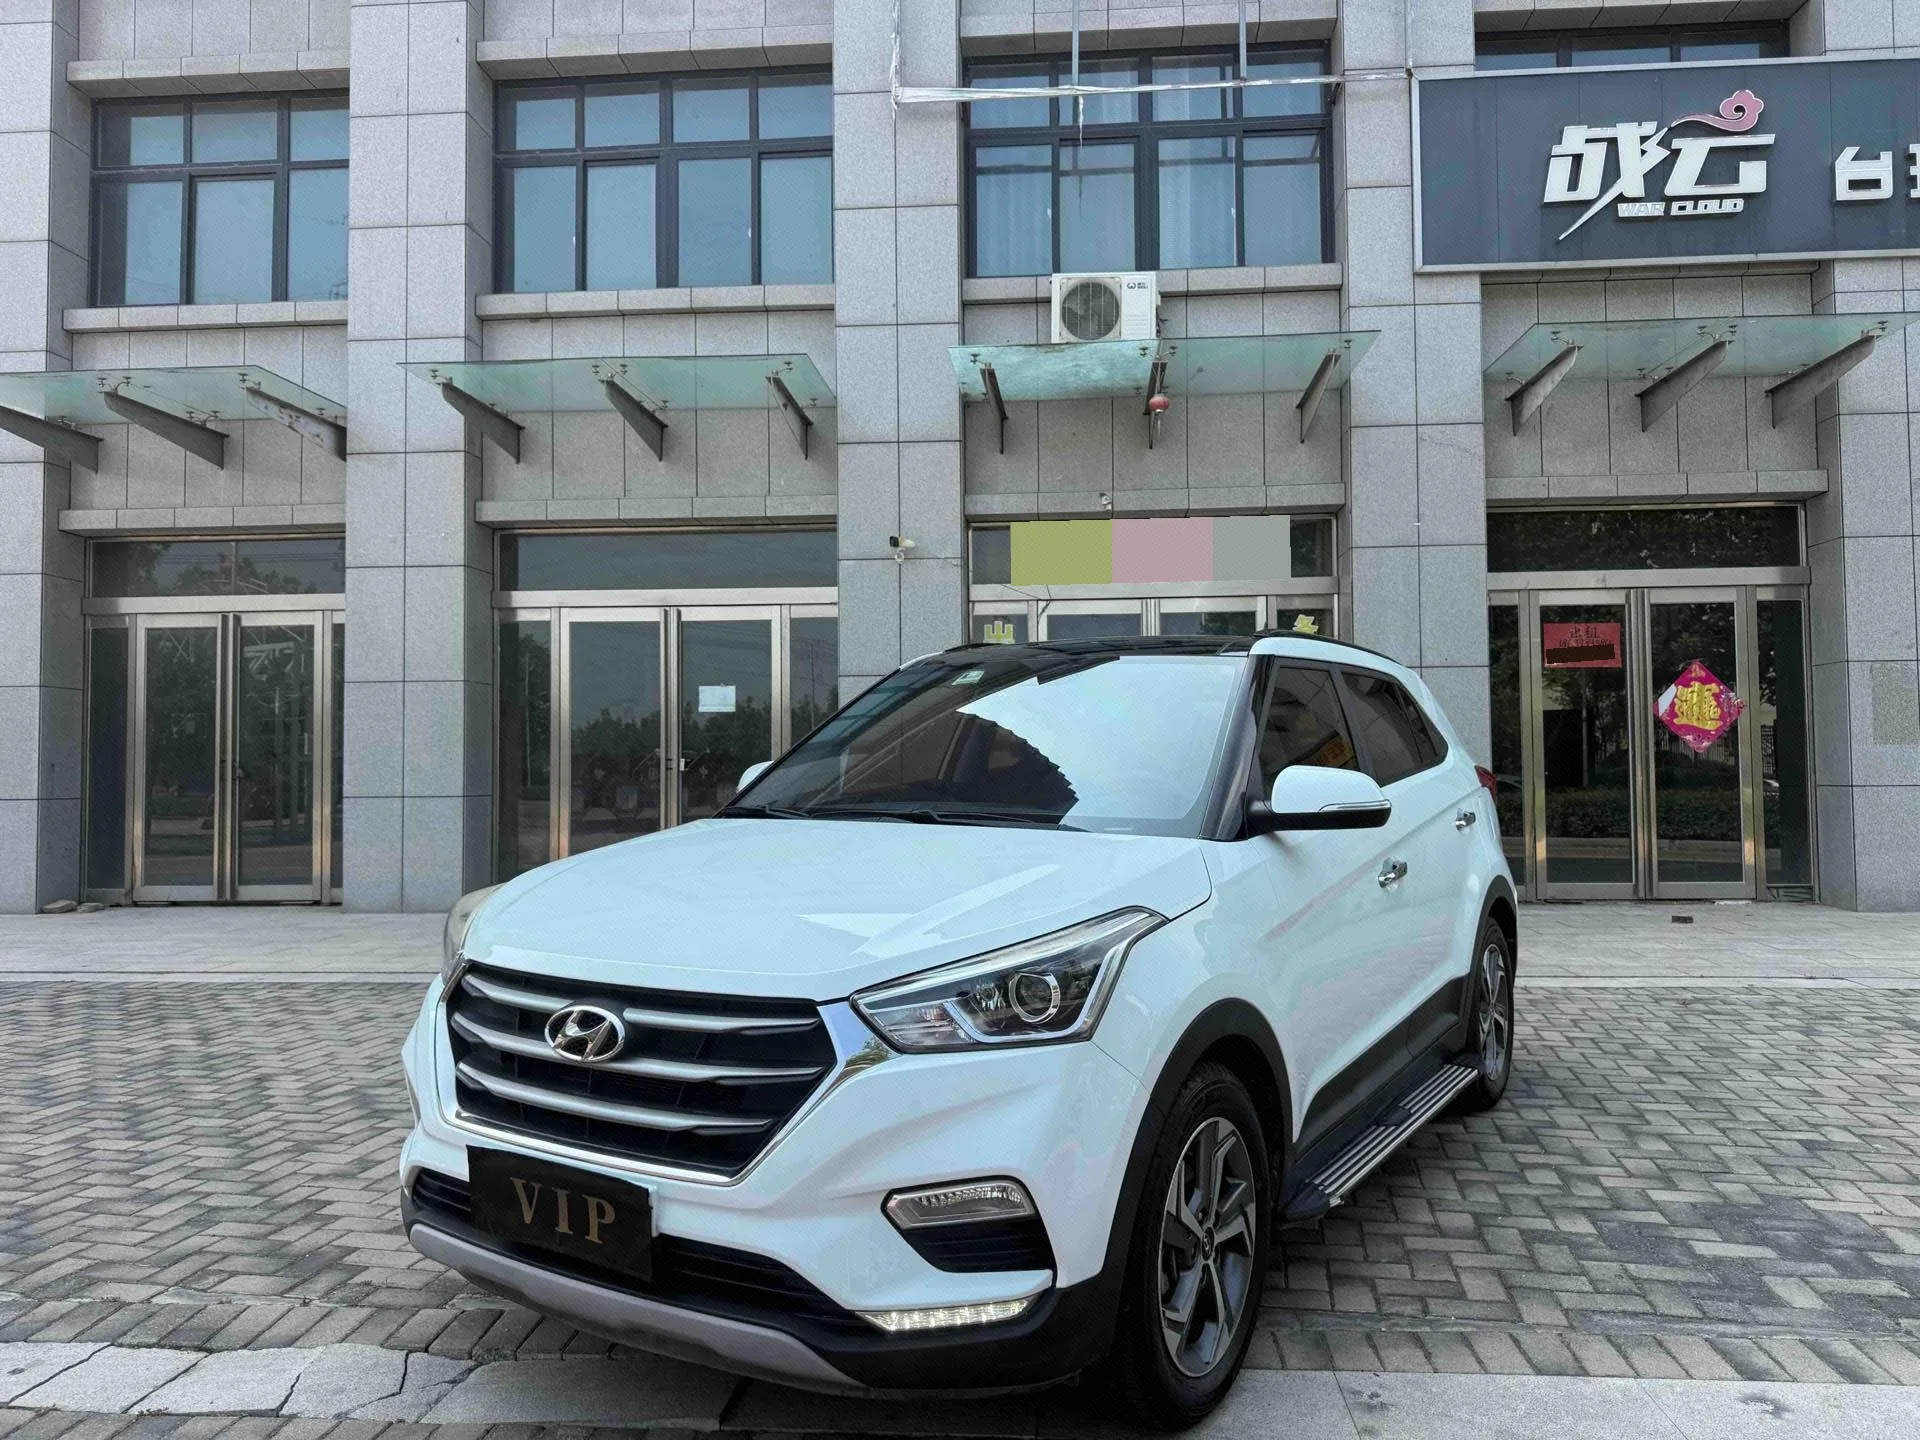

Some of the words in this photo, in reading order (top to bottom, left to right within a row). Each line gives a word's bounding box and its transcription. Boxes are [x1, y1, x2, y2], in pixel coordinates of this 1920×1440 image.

[1835, 144, 1920, 201] 台
[1617, 201, 1665, 217] WAR
[1671, 199, 1744, 215] CLOUD
[509, 1176, 616, 1244] VIP
